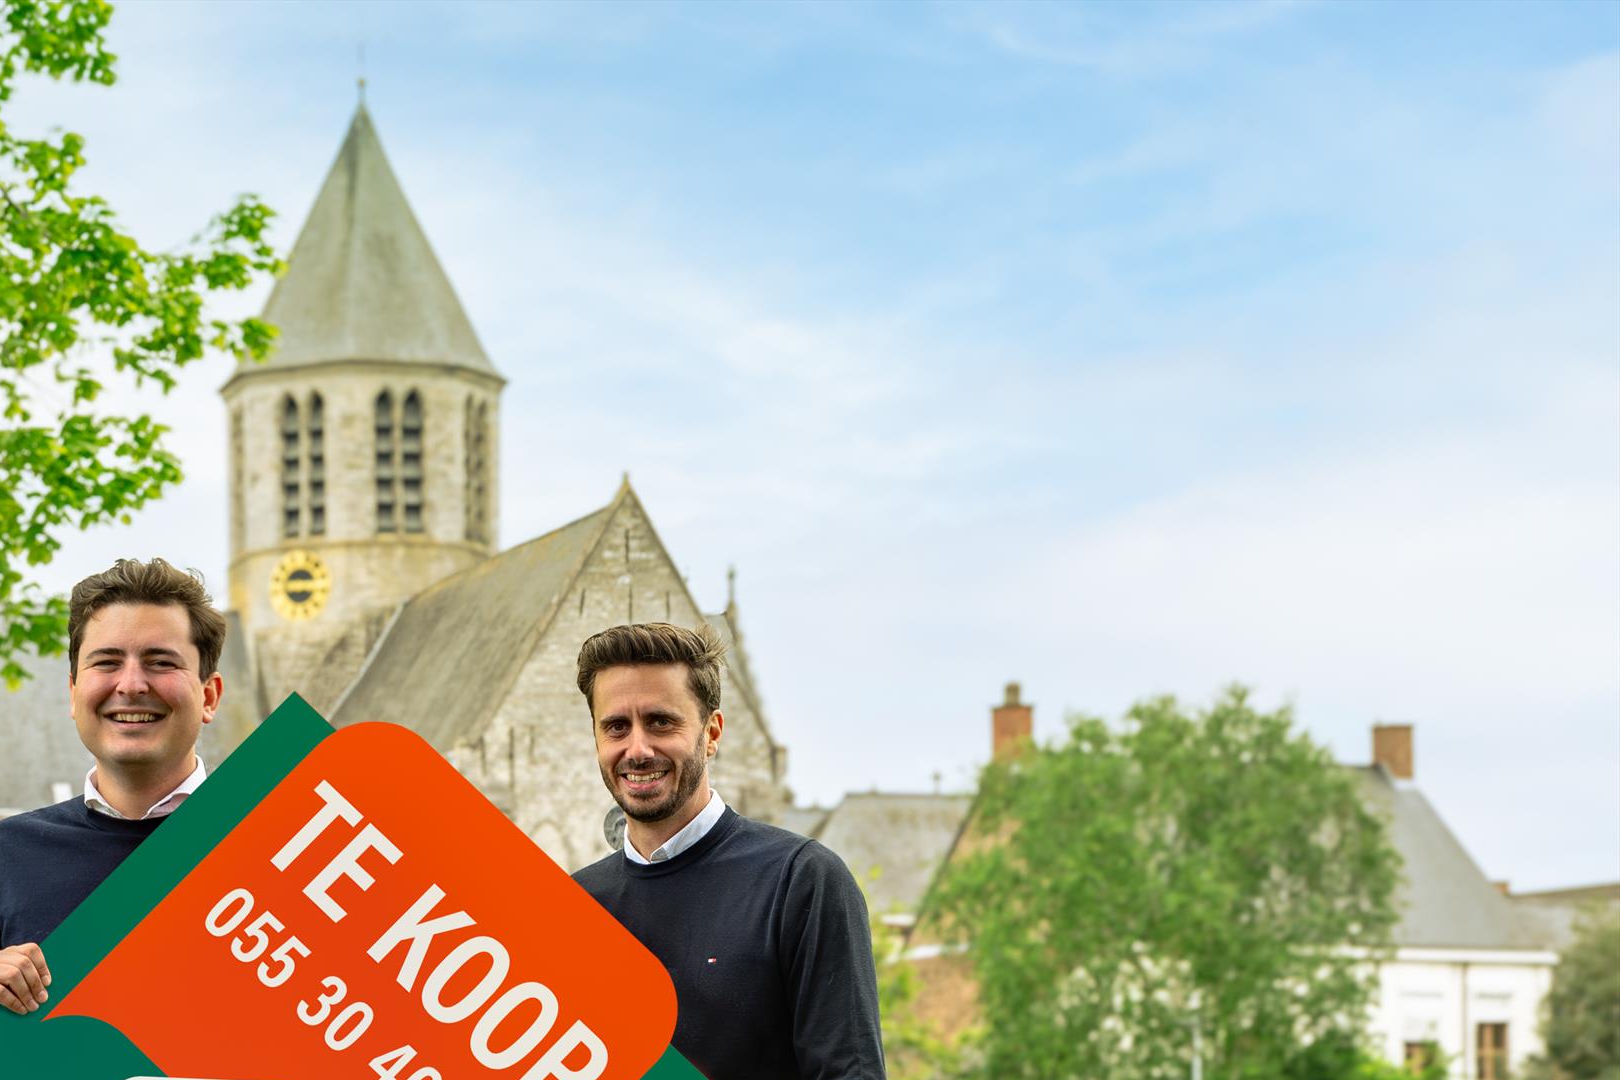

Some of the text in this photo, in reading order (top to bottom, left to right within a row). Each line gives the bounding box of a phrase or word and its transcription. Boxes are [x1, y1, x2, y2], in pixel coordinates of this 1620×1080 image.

[270, 779, 404, 923] TE
[205, 888, 312, 988] 055
[296, 975, 374, 1051] 30
